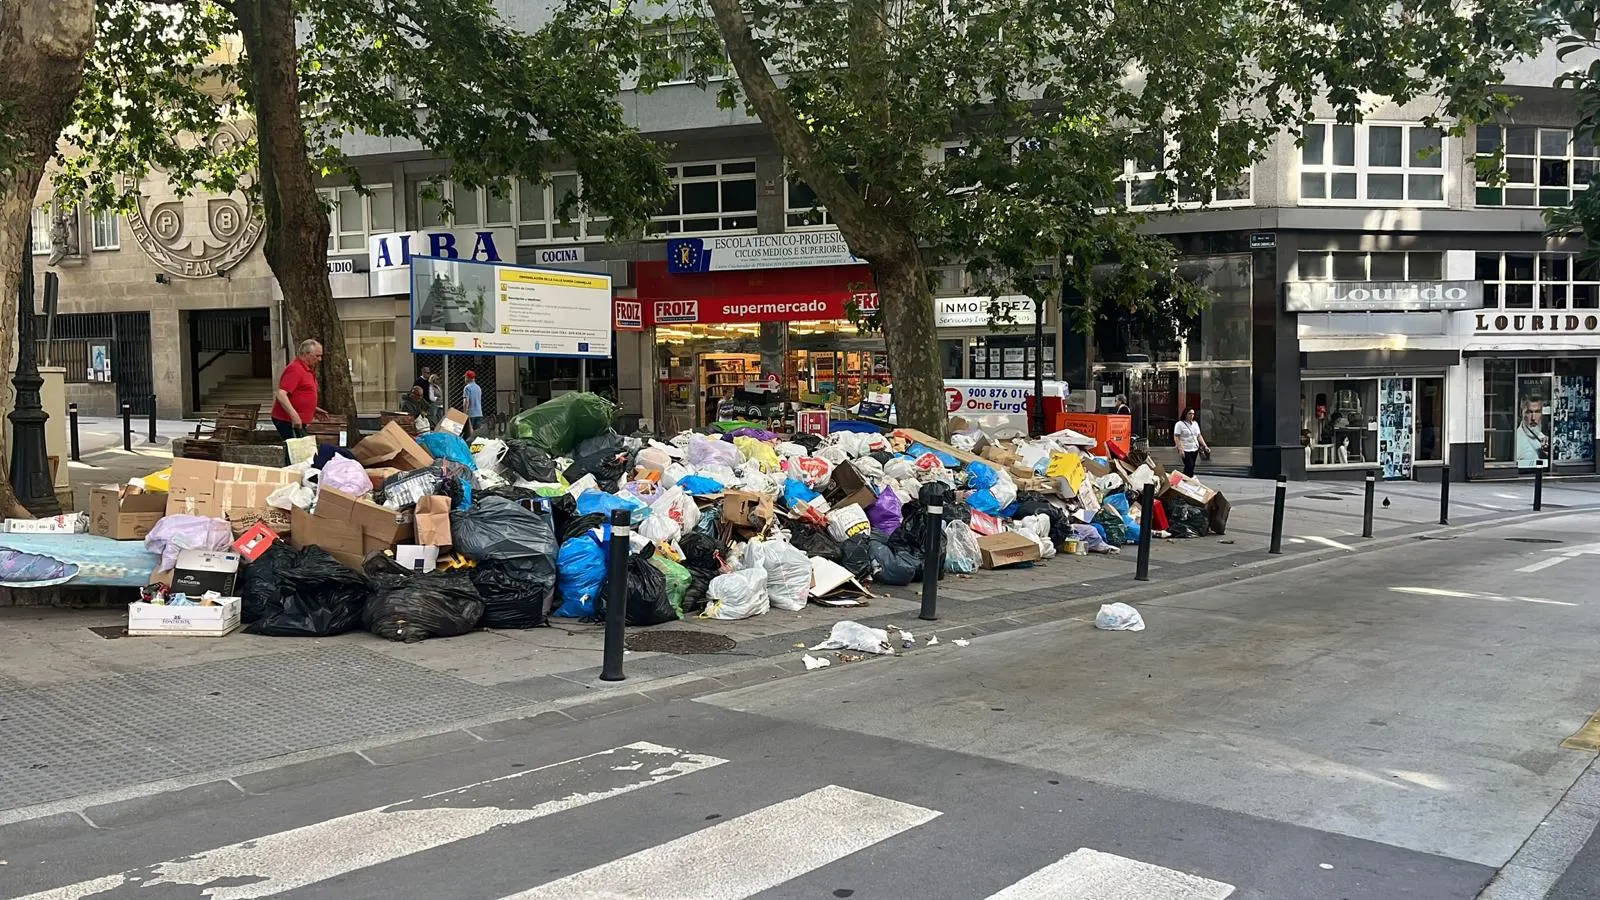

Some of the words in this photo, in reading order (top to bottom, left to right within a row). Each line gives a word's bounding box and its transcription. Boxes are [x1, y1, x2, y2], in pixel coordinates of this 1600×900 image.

[162, 216, 172, 232] P
[221, 212, 232, 229] B
[715, 238, 752, 249] ESCOLA
[734, 249, 761, 258] CICLOS
[762, 247, 793, 257] MEDIOS
[794, 247, 799, 255] E
[800, 245, 847, 255] SUPERIORES
[541, 250, 578, 263] COCINA
[185, 261, 212, 275] PAX
[1326, 284, 1468, 301] Lourido
[616, 303, 640, 320] FROIZ
[655, 301, 696, 317] FROIZ
[722, 299, 827, 317] supermercado
[940, 300, 1031, 313] INMOPREZ
[1475, 314, 1598, 331] LOURIDO
[968, 388, 986, 397] 900
[989, 388, 1008, 398] 876
[1011, 389, 1029, 399] 016
